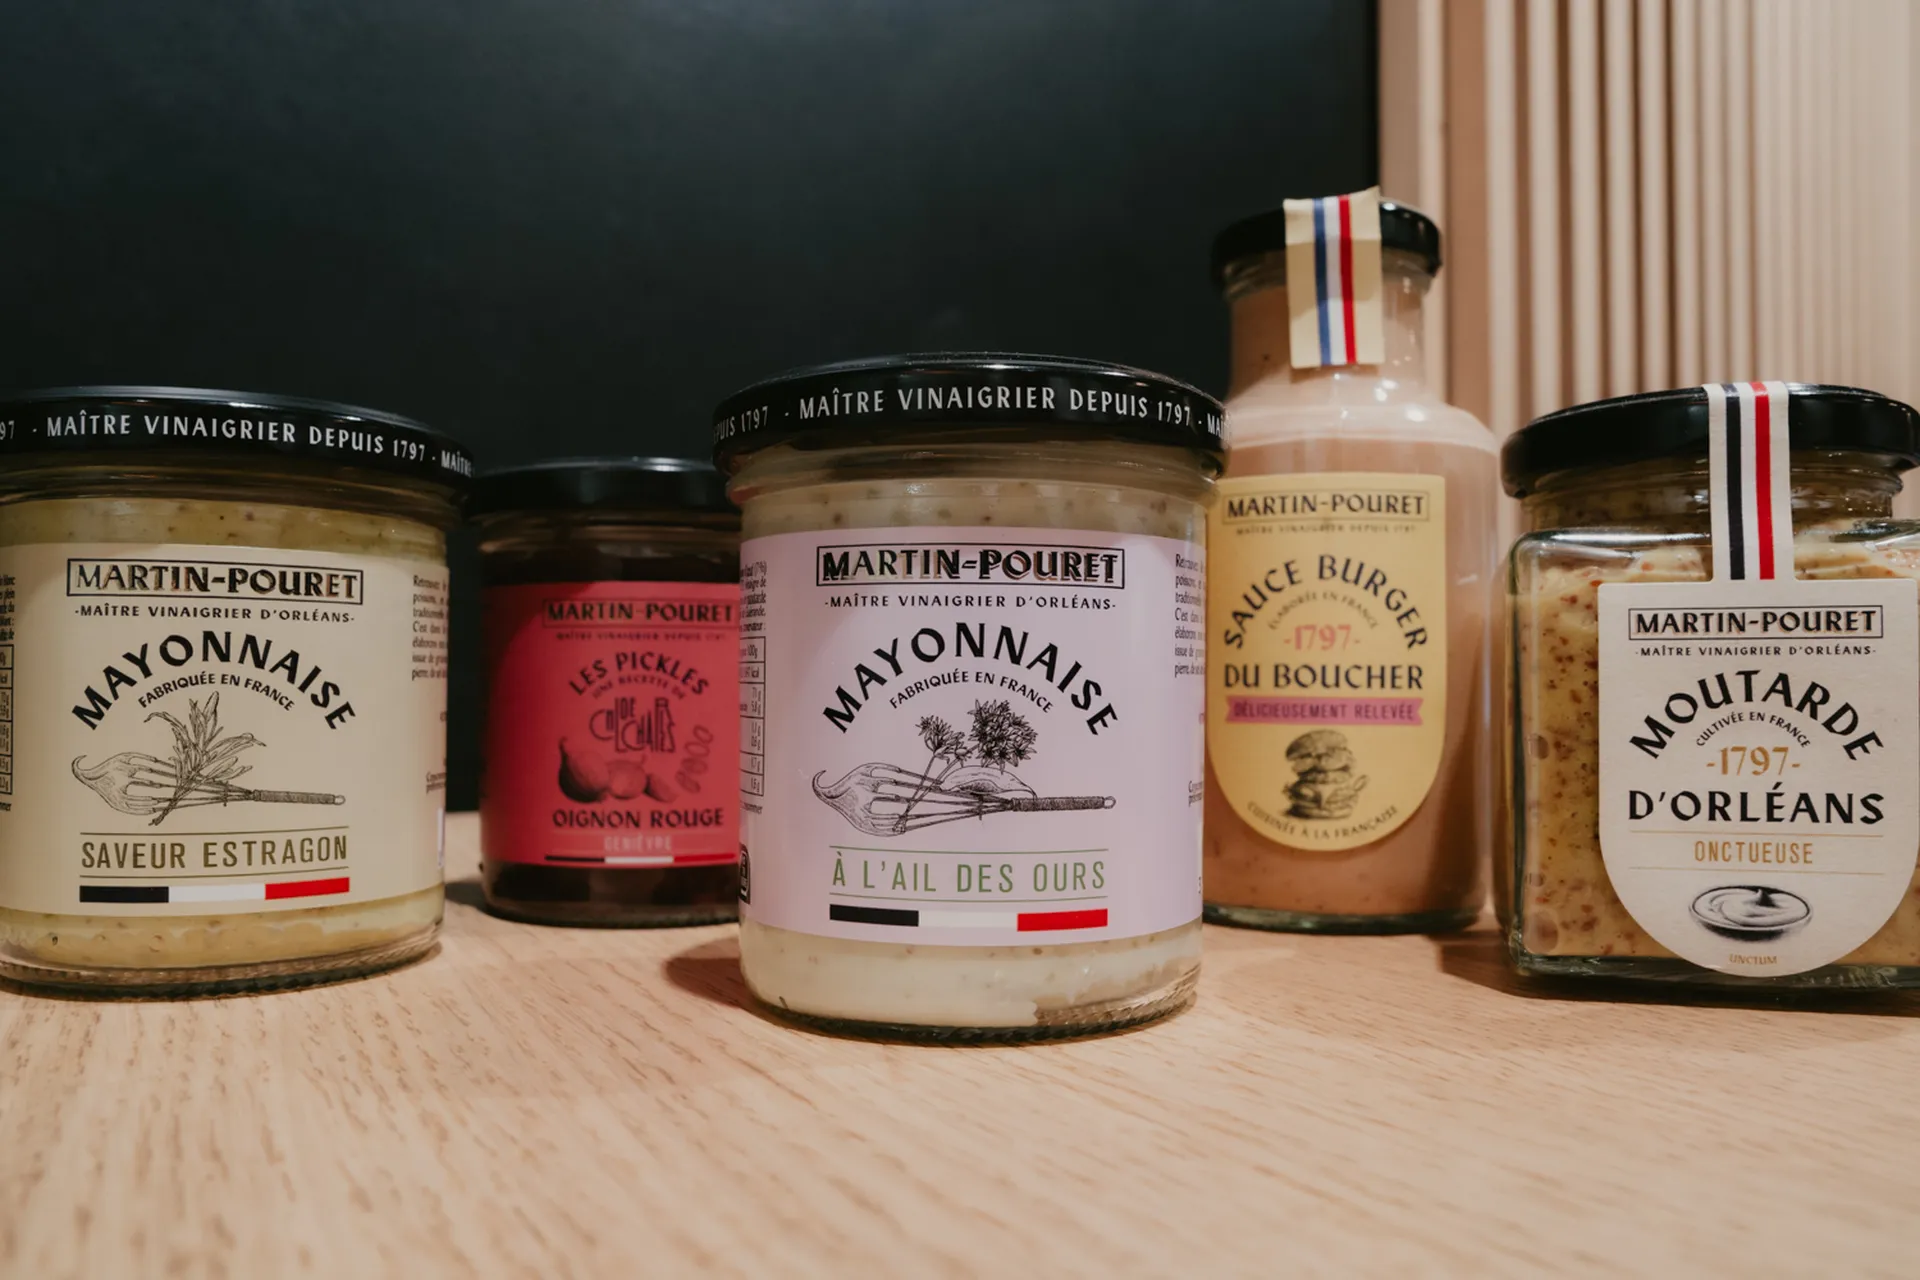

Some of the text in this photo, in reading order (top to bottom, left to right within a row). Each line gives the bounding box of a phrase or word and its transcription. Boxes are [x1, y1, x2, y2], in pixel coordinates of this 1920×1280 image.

[741, 405, 768, 433] 1797
[800, 386, 1190, 427] MAÎTRE VINAIGRIER DEPUIS 1797
[0, 418, 15, 440] 97
[47, 410, 425, 462] MAÎTRE VINAIGRIER DEPUIS 1797
[1227, 494, 1424, 518] MARTIN-POURET
[76, 564, 357, 599] MARTIN-POURET
[822, 548, 1119, 583] MARTIN-POURET
[148, 606, 252, 619] VINAIGRIER
[547, 603, 732, 622] MARTIN-POURET
[898, 593, 1006, 608] VINAIGRIER
[1224, 554, 1427, 650] SAUCE BURGER
[1323, 591, 1338, 601] EN
[1341, 594, 1379, 630] FRANCE
[1636, 610, 1877, 634] MARTIN-POURET
[1700, 645, 1782, 656] VINAIGRIER
[72, 630, 355, 730] MAYONNAISE
[138, 671, 295, 711] FABRIQUÉE EN FRANCE
[569, 651, 710, 696] LES PICKLES
[823, 622, 1118, 735] MAYONNAISE
[889, 668, 1054, 713] FABRIQUÉE EN FRANCE
[1224, 663, 1424, 690] DU BOUCHER
[1234, 701, 1415, 721] DÉLICIEUSEMENT RELEVÉE
[1629, 669, 1884, 760] MOUTARDE
[1696, 711, 1811, 748] CULTIVÉE EN FRANCE
[552, 809, 642, 828] OIGNON
[650, 808, 724, 827] ROUGE
[1628, 782, 1885, 825] D'ORLÉANS
[1314, 828, 1330, 840] LA
[1335, 805, 1398, 838] FRANÇAISE
[81, 835, 348, 869] SAVEUR ESTRAGON
[1694, 840, 1814, 865] ONCTUEUSE
[832, 851, 1106, 893] À L'AIL DES OURS
[1728, 954, 1778, 965] UNCTUM
